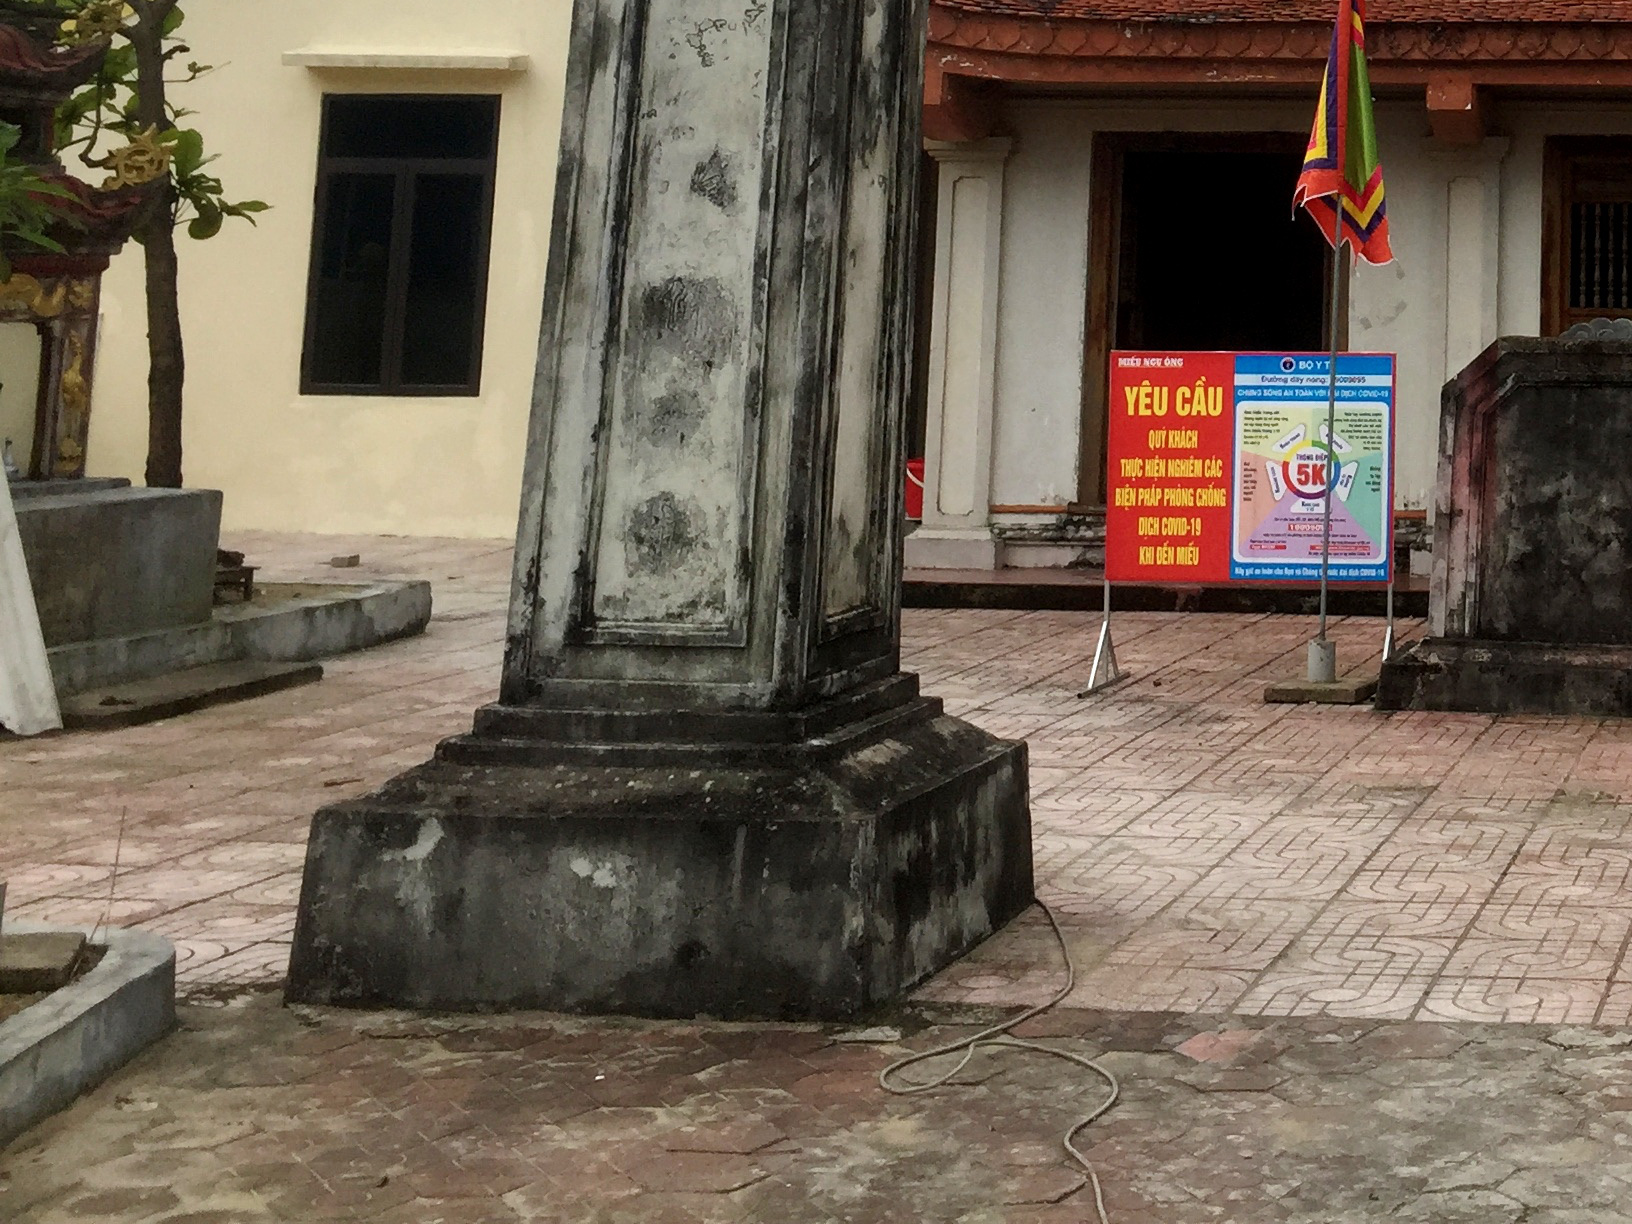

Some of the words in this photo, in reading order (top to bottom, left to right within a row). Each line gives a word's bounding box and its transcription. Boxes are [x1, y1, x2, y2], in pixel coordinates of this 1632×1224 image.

[1299, 360, 1313, 370] BỘ
[1316, 360, 1322, 369] Y
[1124, 380, 1168, 416] YÊU
[1175, 376, 1223, 417] CẦU
[1358, 389, 1388, 398] COVID-19
[1148, 426, 1166, 450] QUÝ
[1168, 426, 1198, 449] KHÁCH
[1120, 457, 1143, 481] THỰC
[1145, 455, 1166, 481] HIỆN
[1167, 455, 1202, 478] NGHIÊM
[1204, 455, 1223, 478] CÁC
[1296, 453, 1313, 461] THÔNG
[1296, 463, 1326, 486] 5K
[1115, 483, 1136, 510] BIỆN
[1138, 483, 1162, 507] PHÁP
[1163, 483, 1194, 507] PHÒNG
[1196, 482, 1227, 507] CHỐNG
[1138, 517, 1160, 540] DỊCH
[1161, 517, 1201, 536] COVID-19
[1139, 546, 1155, 565] KHI
[1156, 540, 1174, 565] ĐẾN
[1176, 541, 1199, 565] MIẾU
